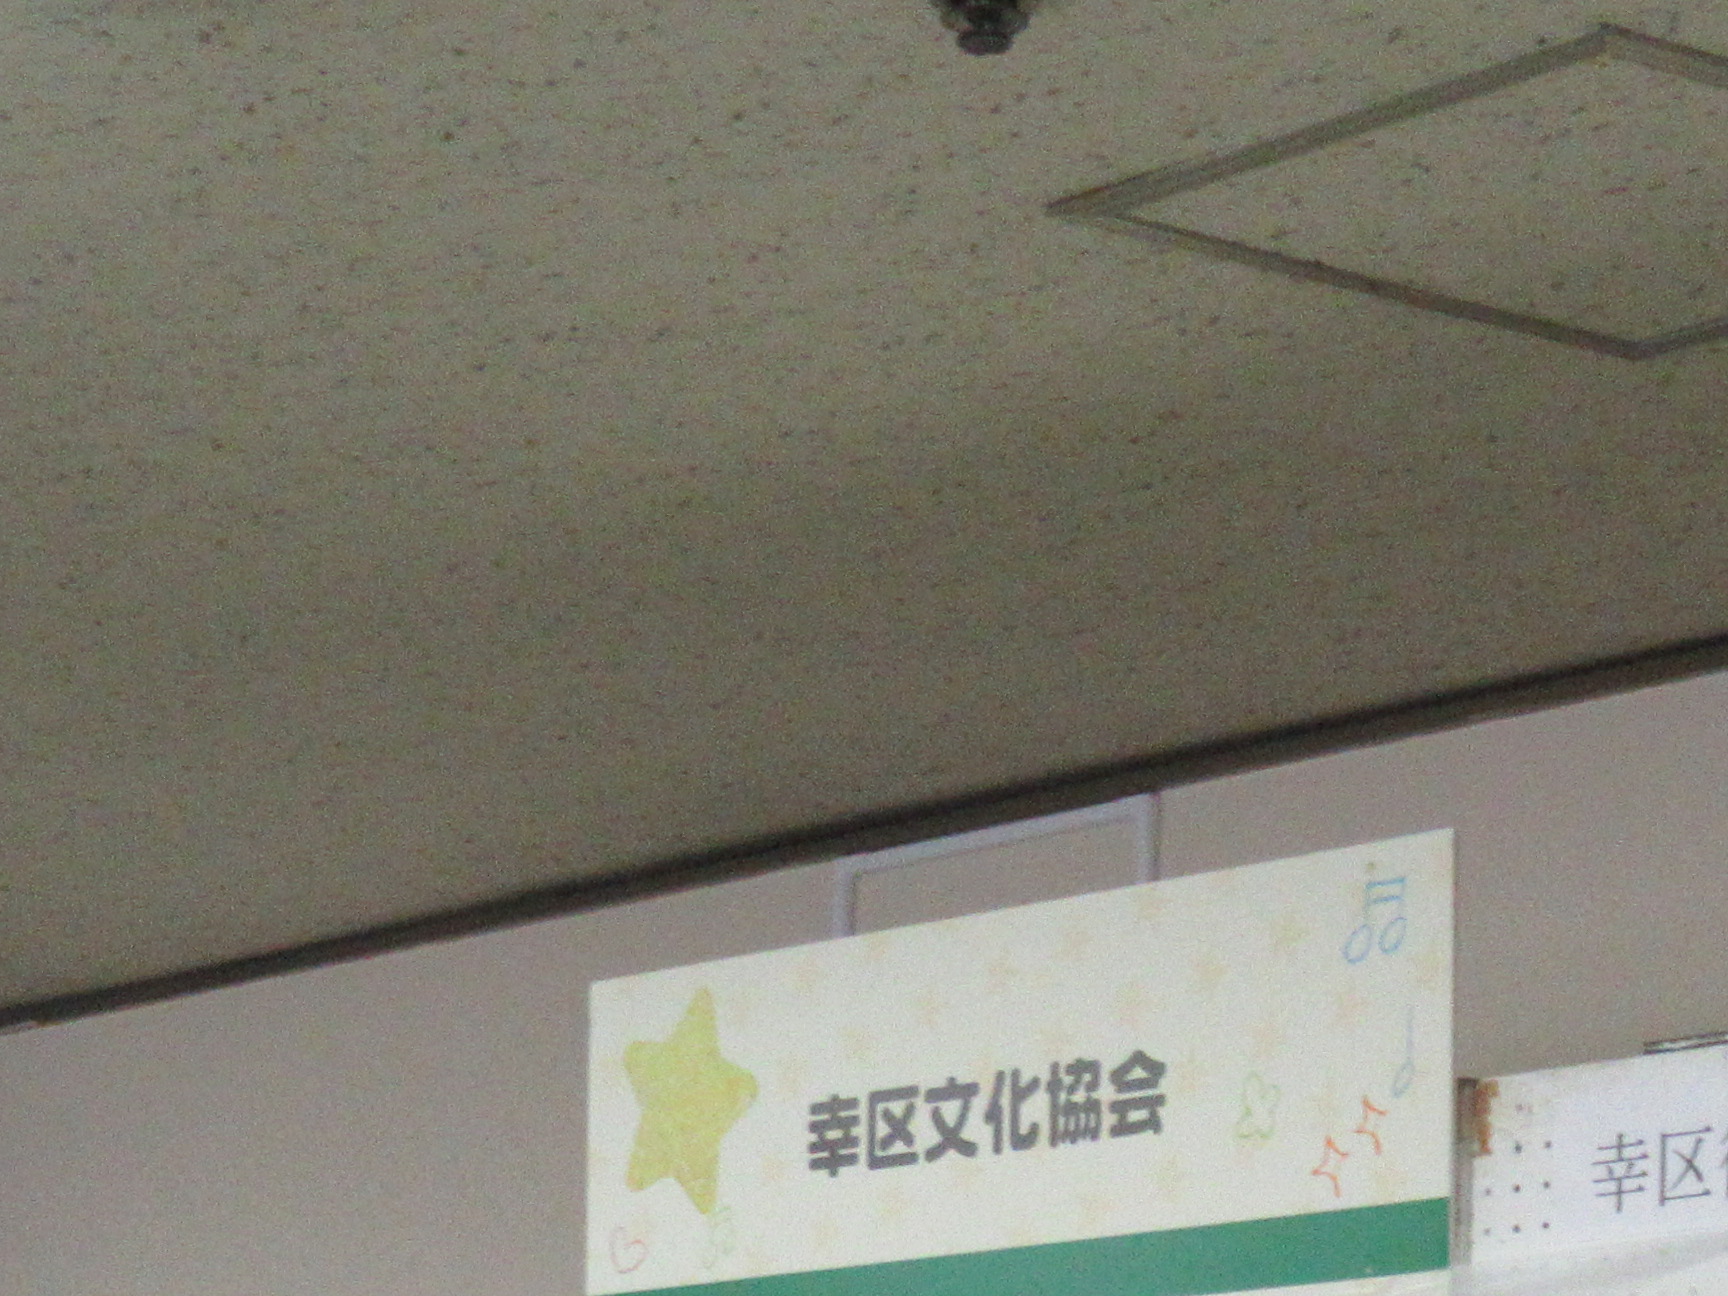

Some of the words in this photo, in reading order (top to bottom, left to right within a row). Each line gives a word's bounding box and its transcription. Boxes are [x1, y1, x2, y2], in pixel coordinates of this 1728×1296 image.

[806, 1049, 1168, 1179] 幸区文化協会
